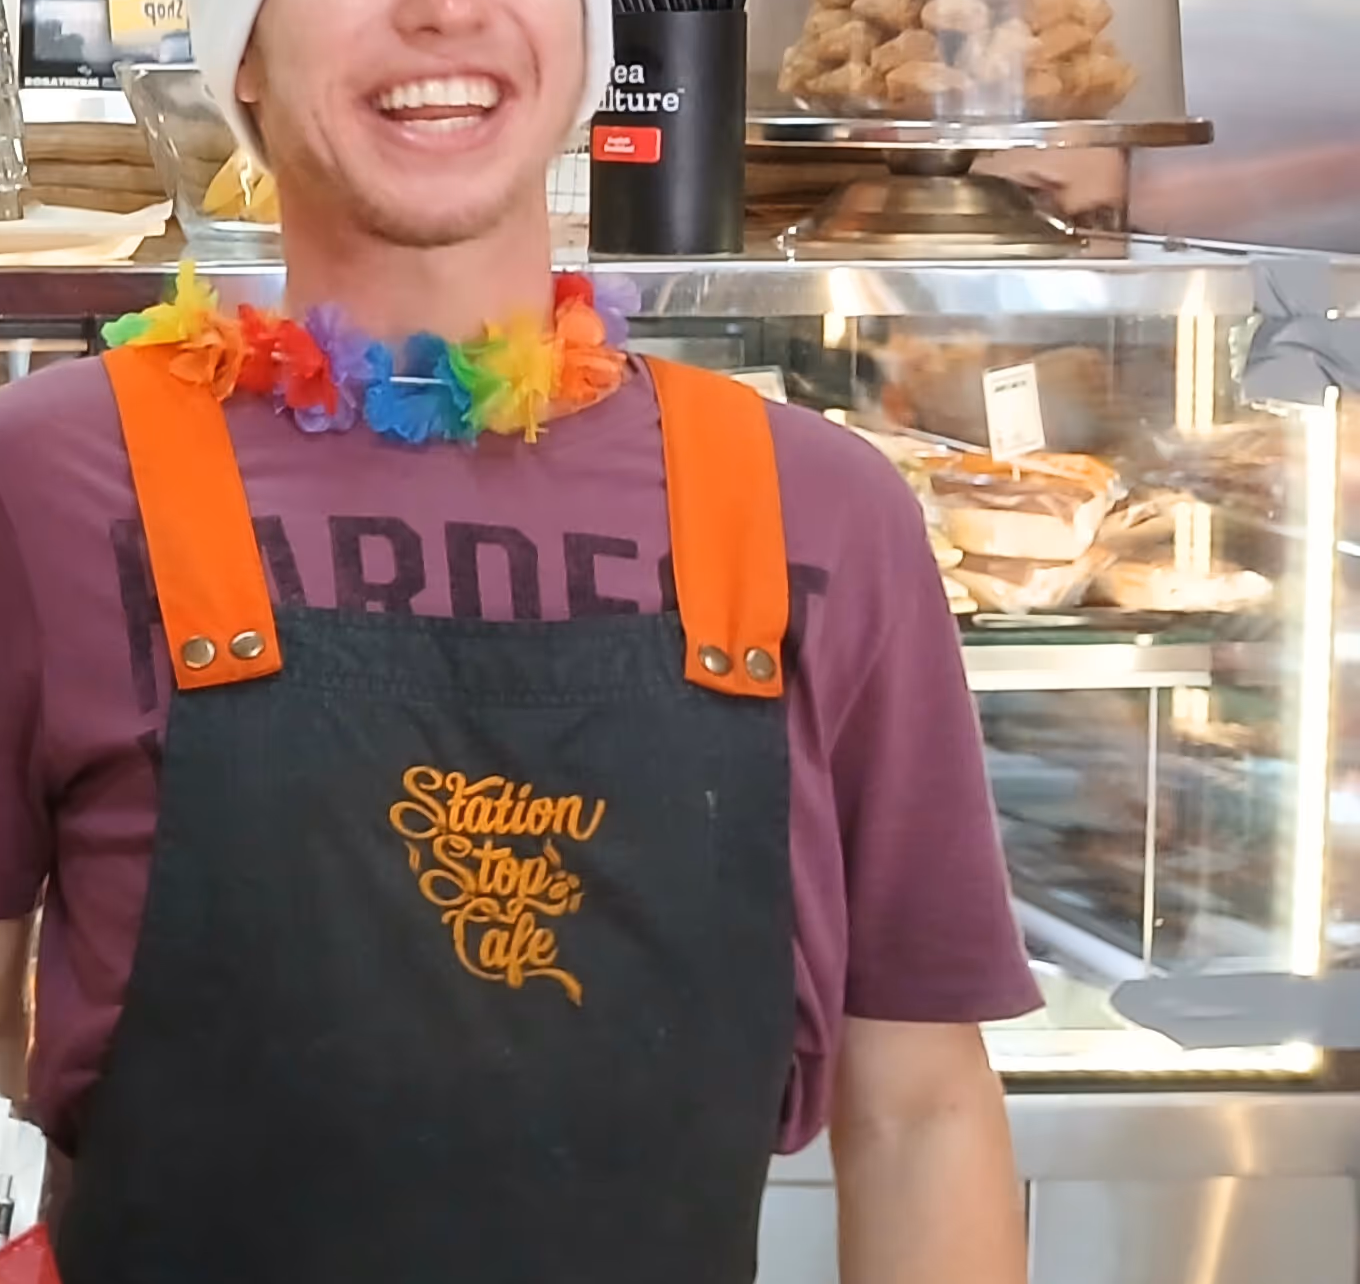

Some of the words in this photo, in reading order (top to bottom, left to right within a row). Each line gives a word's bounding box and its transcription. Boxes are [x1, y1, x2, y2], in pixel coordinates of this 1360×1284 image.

[609, 64, 645, 84] ea
[389, 765, 606, 841] Station
[441, 897, 583, 1007] Cafe
